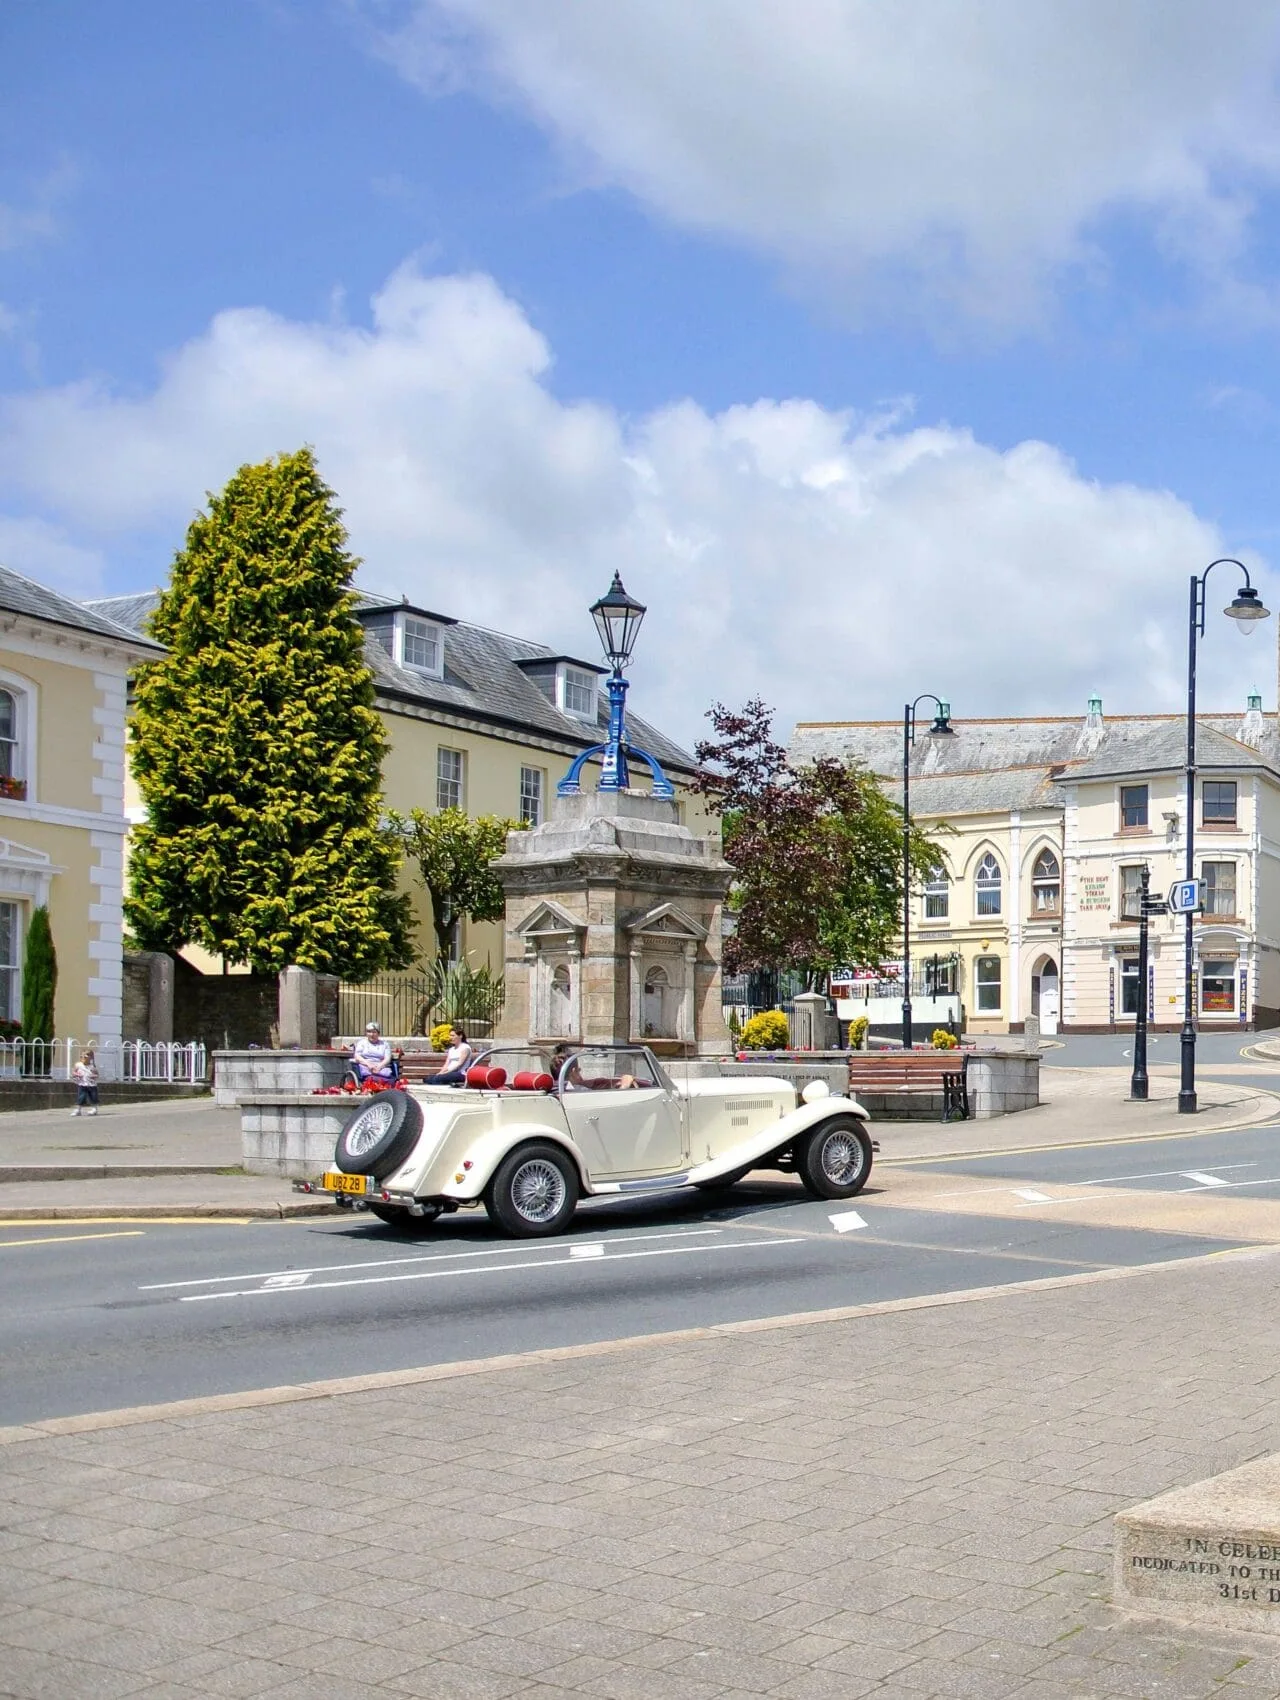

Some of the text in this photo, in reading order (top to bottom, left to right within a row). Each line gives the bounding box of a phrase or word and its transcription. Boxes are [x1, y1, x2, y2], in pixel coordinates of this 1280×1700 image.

[349, 1177, 360, 1191] 28
[1185, 1538, 1209, 1554] IN
[1132, 1556, 1220, 1575] DEDICATED
[1228, 1565, 1250, 1578] TO
[1219, 1583, 1258, 1600] 31st
